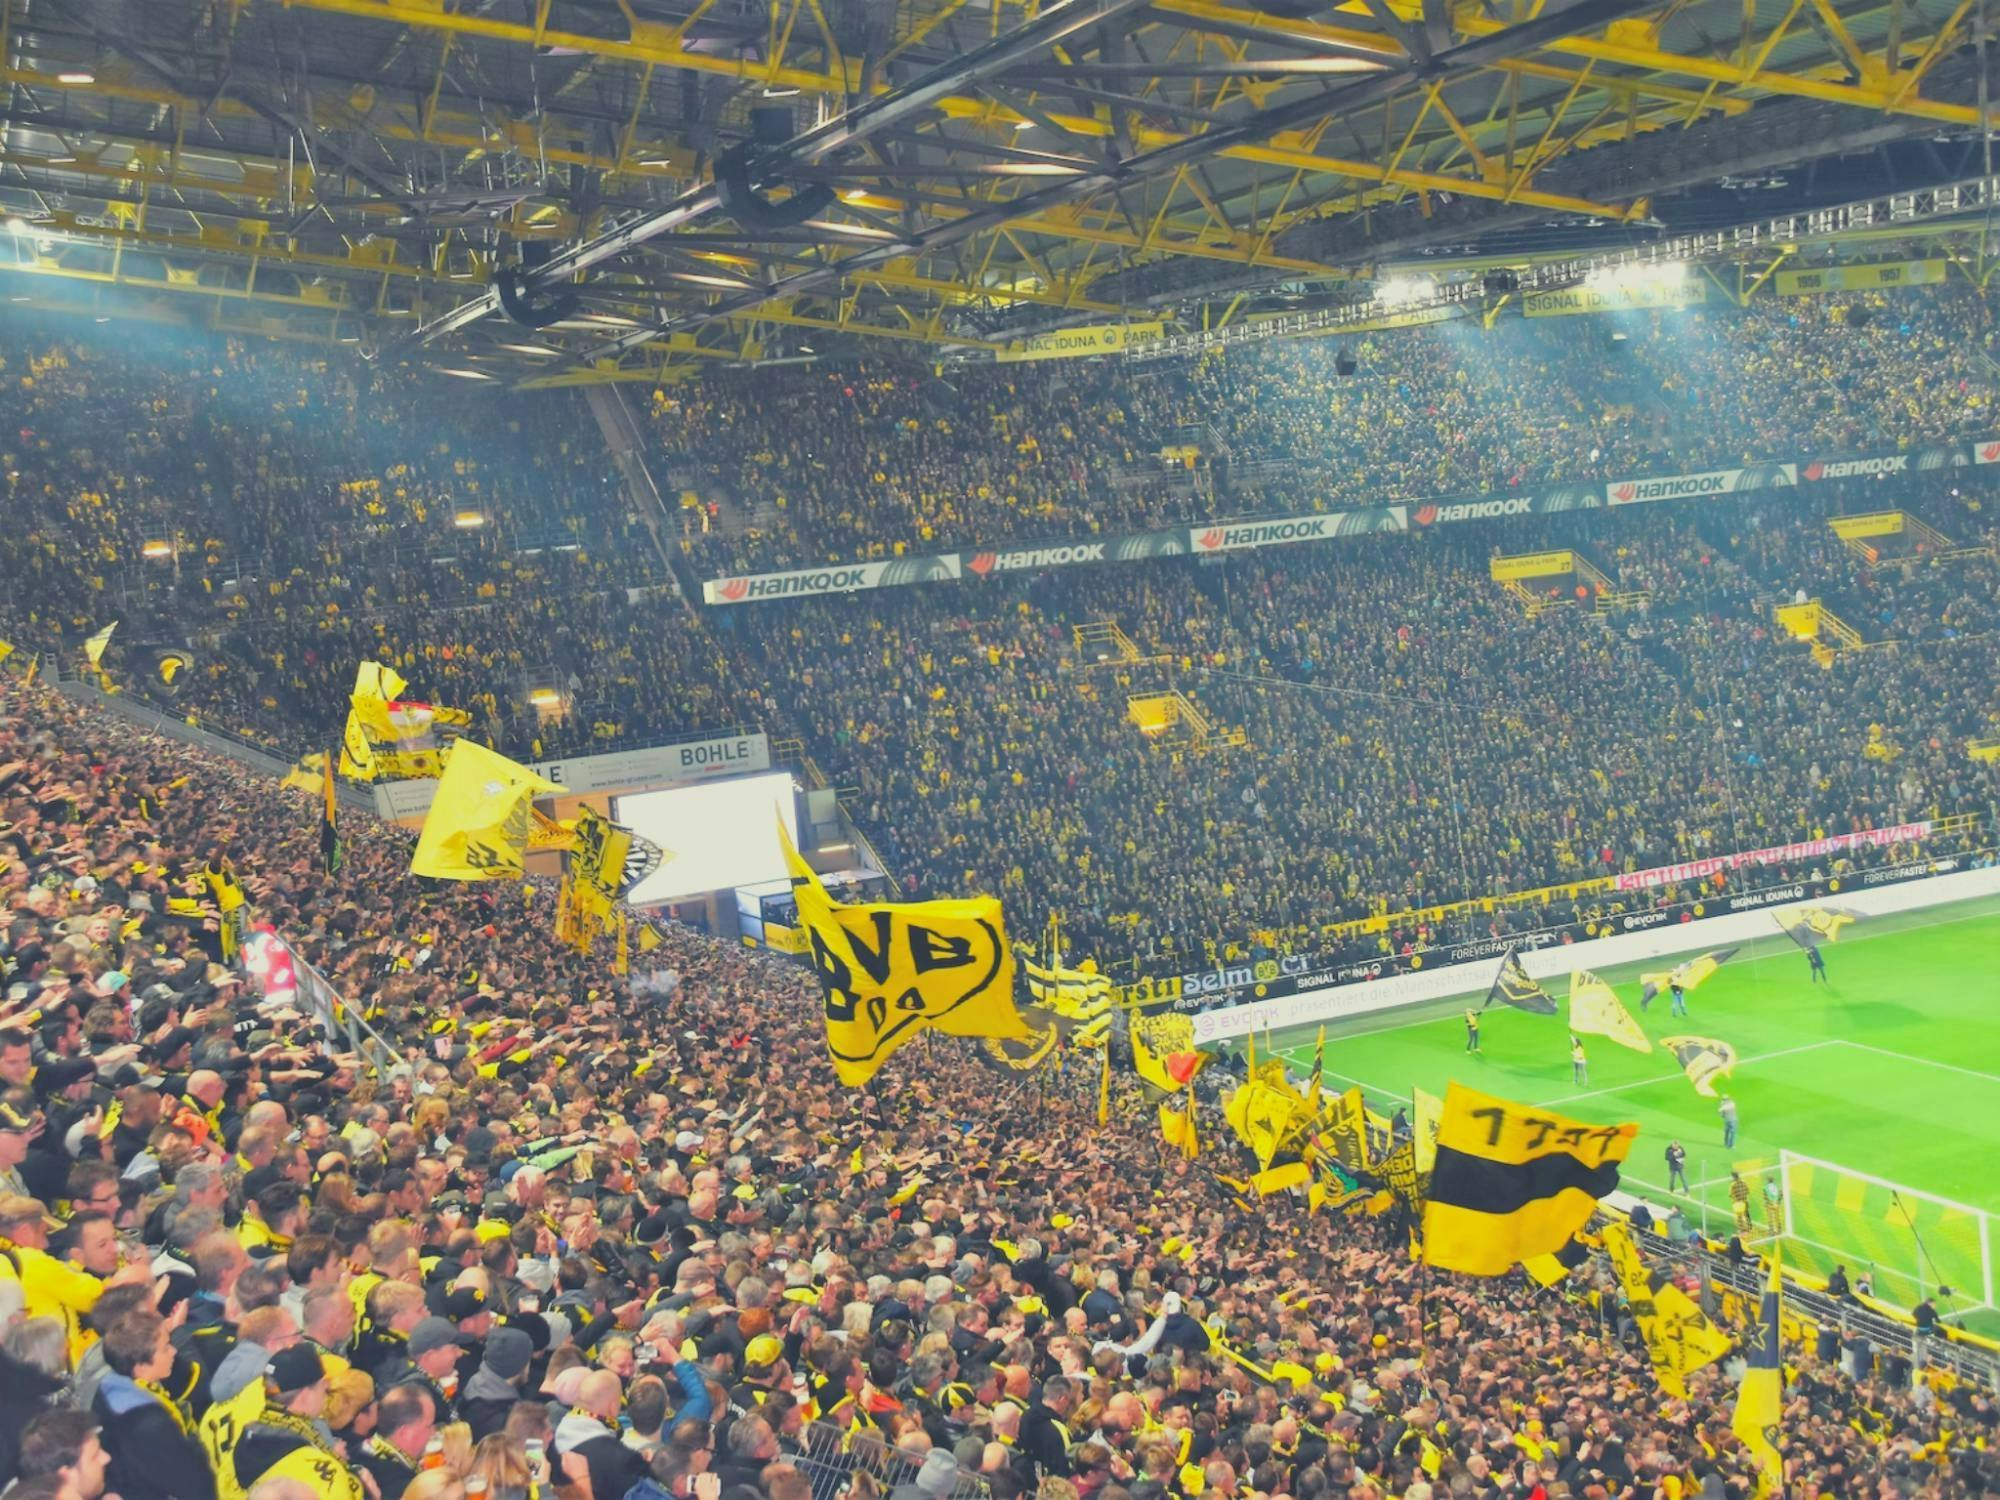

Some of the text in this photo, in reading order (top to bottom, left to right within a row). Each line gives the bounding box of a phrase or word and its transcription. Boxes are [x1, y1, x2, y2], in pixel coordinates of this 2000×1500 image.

[1527, 293, 1582, 312] SIGNAL
[1055, 335, 1096, 350] IDUNA
[1123, 330, 1158, 344] PARK
[680, 741, 748, 767] BOHLE
[1730, 889, 1793, 910] SIGNAL IDUNA
[810, 911, 977, 1022] BVB
[1297, 972, 1337, 989] SIGNAL
